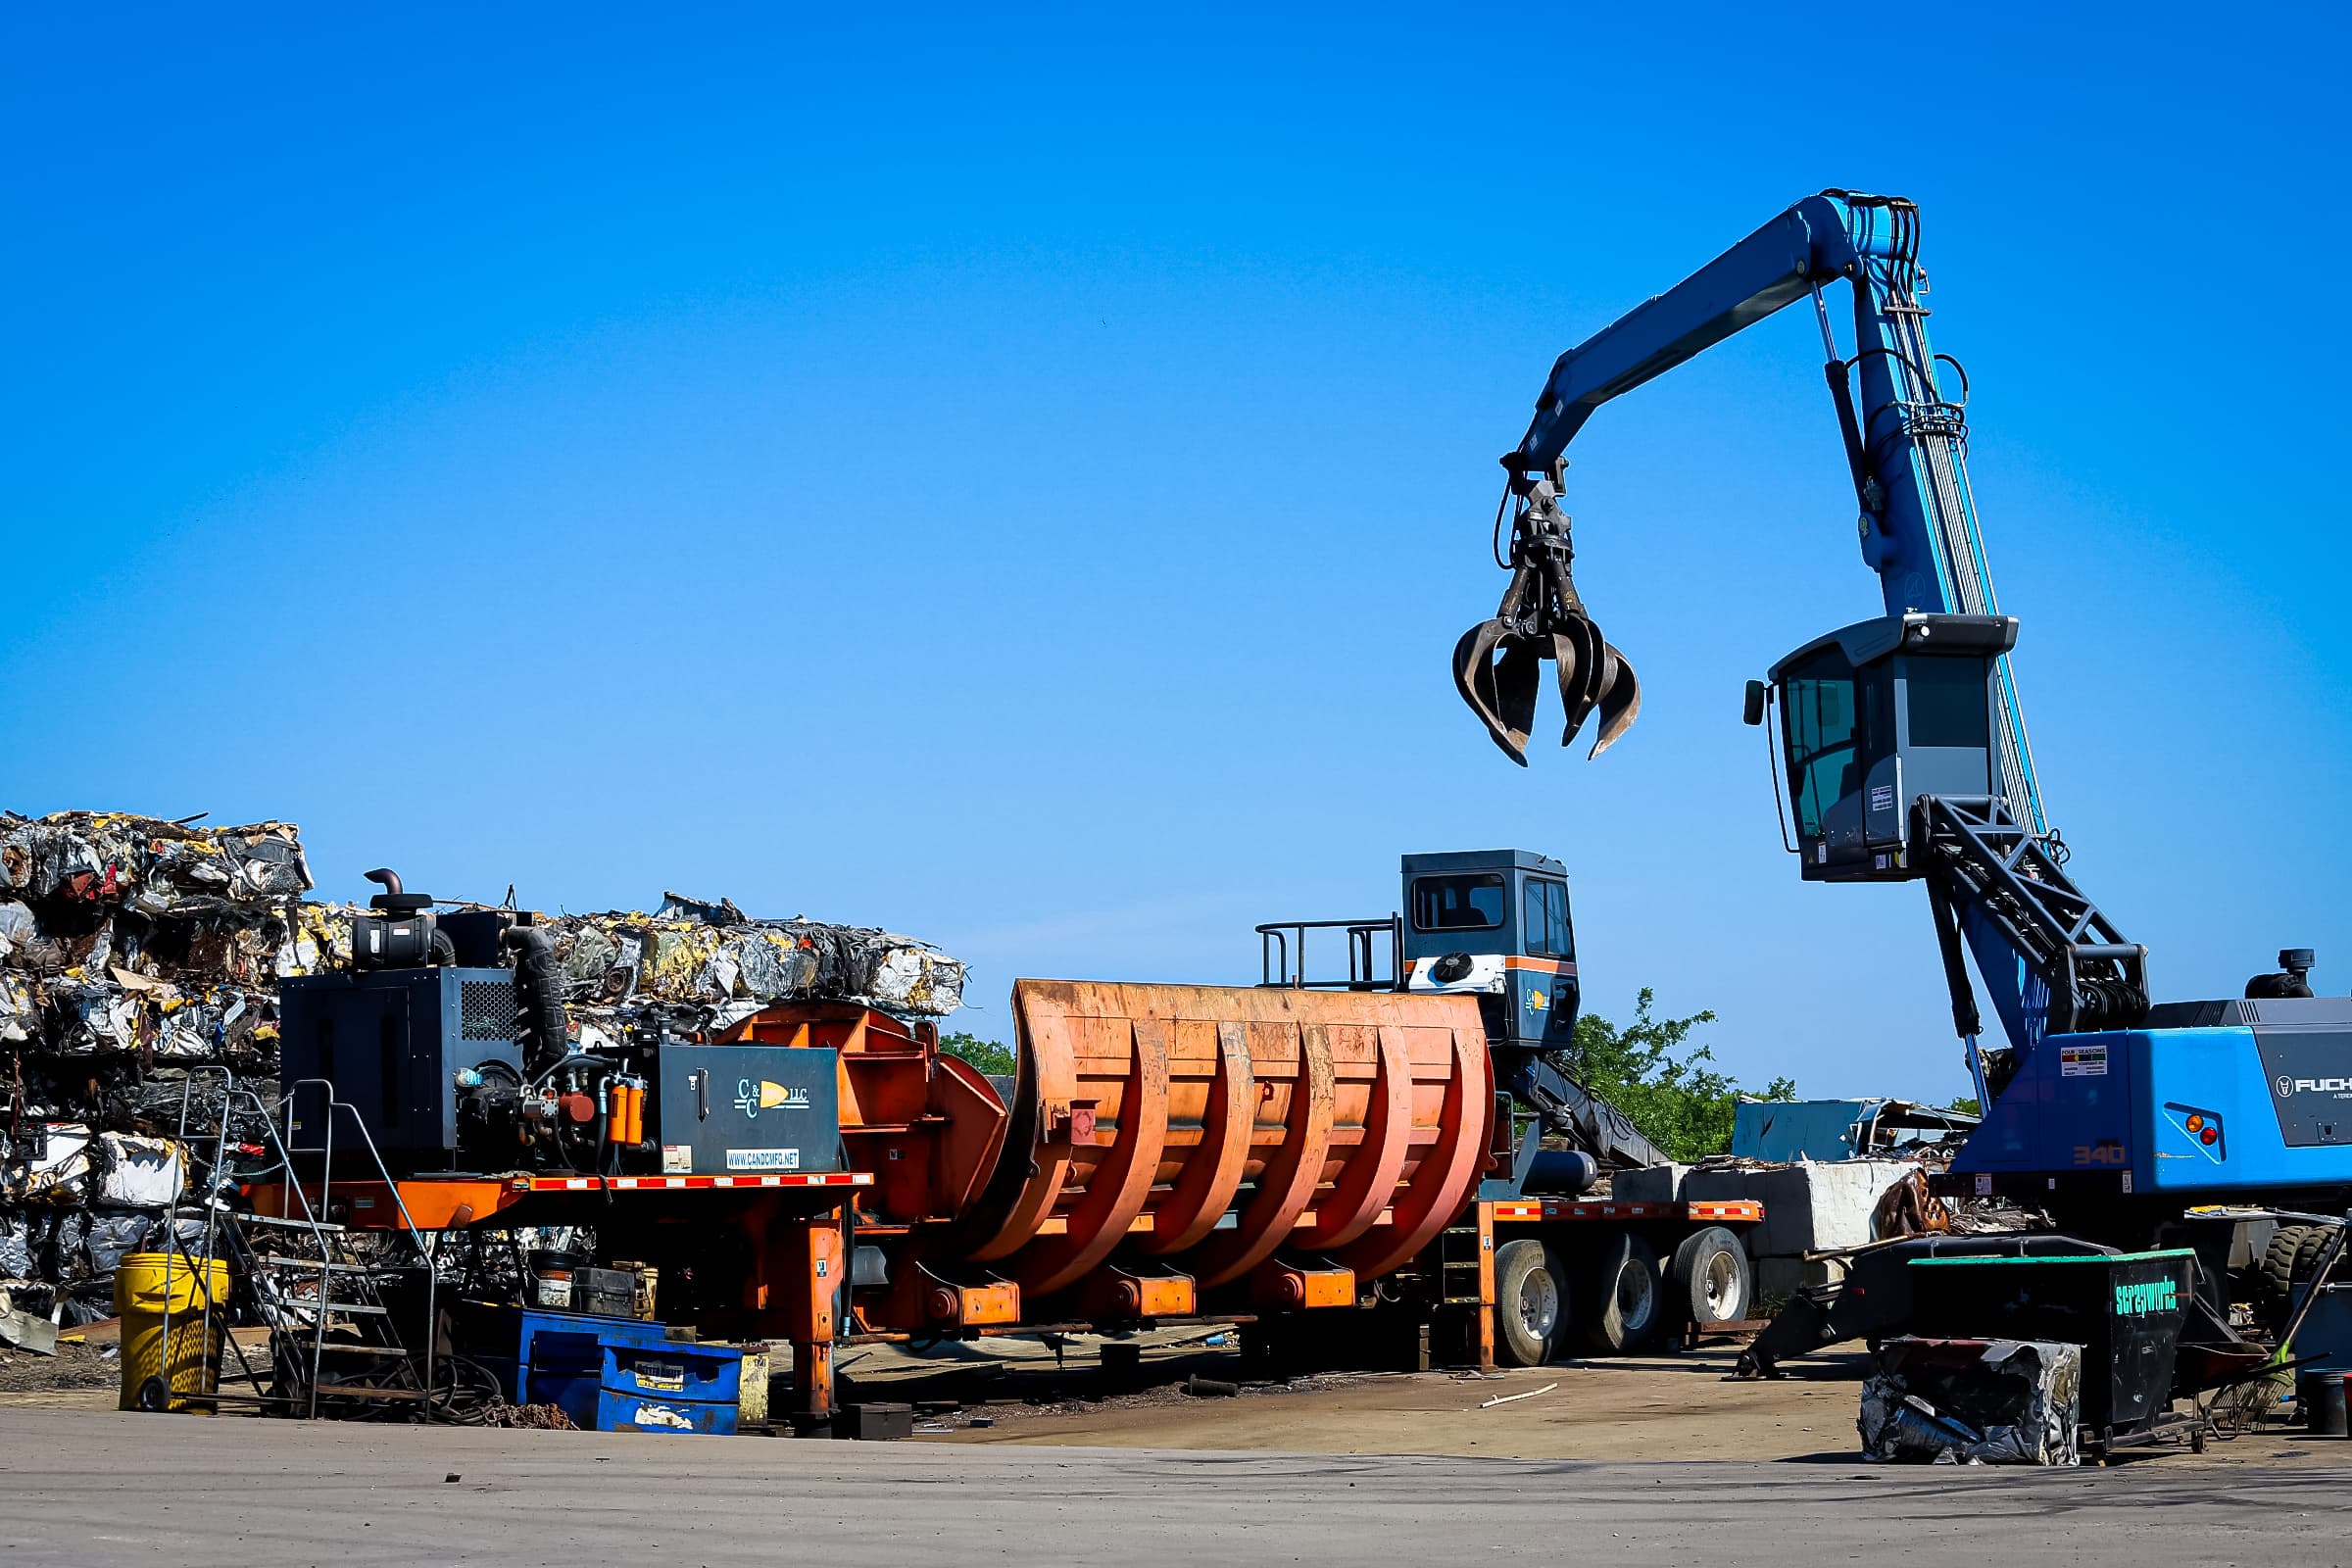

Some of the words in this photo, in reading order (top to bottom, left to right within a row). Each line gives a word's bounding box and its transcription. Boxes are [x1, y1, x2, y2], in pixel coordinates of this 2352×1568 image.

[738, 1078, 750, 1099] C
[752, 1084, 760, 1098] &
[789, 1088, 808, 1101] LLC
[746, 1098, 758, 1118] C
[728, 1152, 798, 1166] WWW.CANDCMFG.NET
[2074, 1146, 2126, 1164] 340
[2115, 1275, 2177, 1318] scrapworks
